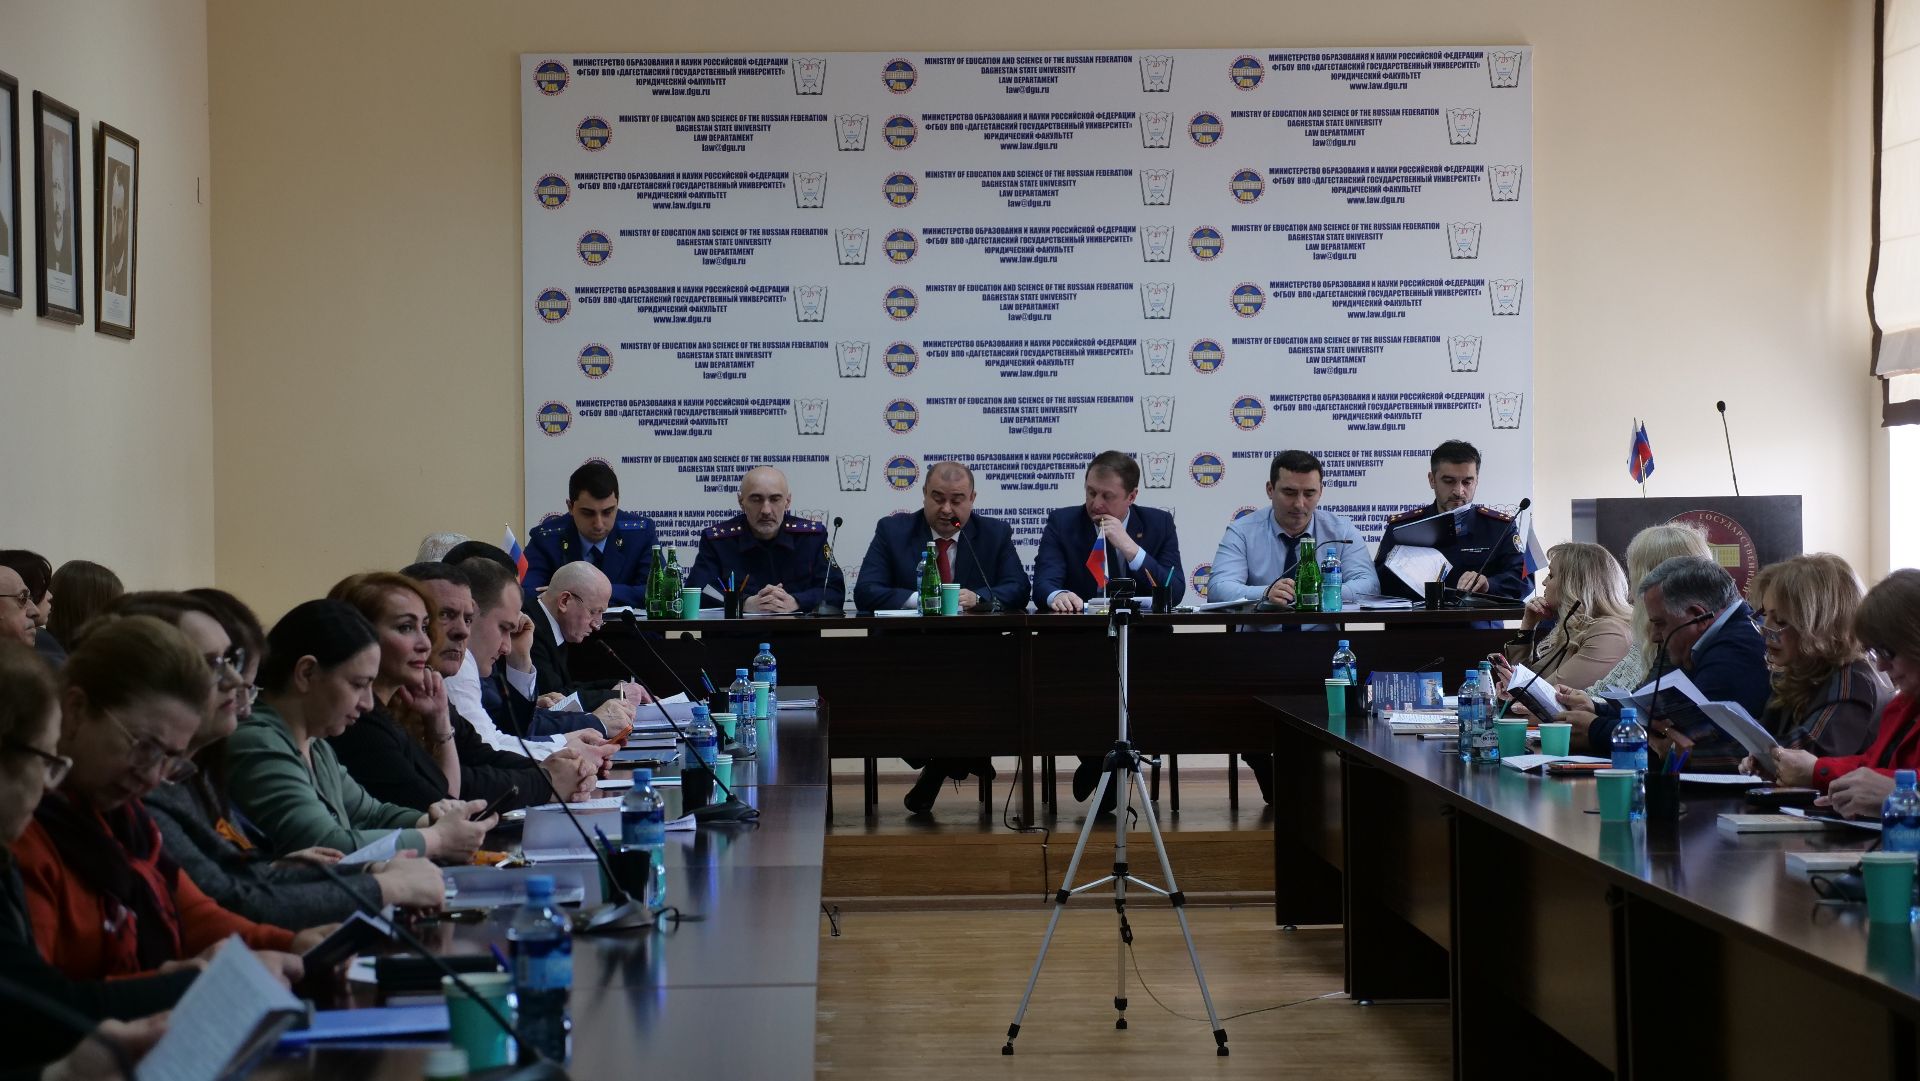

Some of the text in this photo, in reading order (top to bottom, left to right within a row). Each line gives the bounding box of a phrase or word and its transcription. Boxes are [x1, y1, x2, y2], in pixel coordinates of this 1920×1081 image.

[675, 58, 680, 66] И
[681, 58, 702, 66] НАУКИ
[748, 57, 788, 66] ФЕДЕРАЦИИ
[924, 57, 955, 65] MINISTRY
[956, 57, 964, 65] OF
[965, 57, 1001, 65] EDUCATION
[1002, 56, 1015, 64] AND
[1016, 56, 1043, 64] SCIENCE
[1044, 56, 1052, 64] OF
[1053, 56, 1065, 64] THE
[1066, 56, 1094, 64] RUSSIAN
[577, 69, 599, 77] ФГБОУ
[602, 68, 616, 77] ВПО
[981, 66, 1018, 74] DAGHESTAN
[1019, 66, 1037, 74] STATE
[687, 77, 726, 85] ФАКУЛЬТЕТ
[998, 76, 1013, 84] LAW
[652, 88, 710, 96] www.law.dgu.ru
[1231, 110, 1261, 118] MINISTRY
[1263, 110, 1270, 118] OF
[1272, 109, 1307, 117] EDUCATION
[1308, 109, 1321, 117] AND
[1322, 109, 1349, 117] SCIENCE
[1350, 109, 1358, 117] OF
[1360, 109, 1371, 117] THE
[1372, 109, 1400, 117] RUSSIAN
[1287, 119, 1324, 127] DAGHESTAN
[1325, 119, 1343, 127] STATE
[922, 225, 1137, 235] МИНИСТЕРСТВО ОБРАЗОВАНИЯ И НАУКИ РОССИЙСКОЙ ФЕДЕРАЦИИ
[1231, 222, 1439, 232] MINISTRY OF EDUCATION AND SCIENCE OF THE RUSSIAN FEDERATION
[620, 227, 828, 237] MINISTRY OF EDUCATION AND SCIENCE OF THE RUSSIAN FEDERATION
[925, 237, 948, 245] ФГБОУ
[950, 236, 964, 245] ВПО
[1020, 235, 1085, 244] ГОСУДАРСТВЕННЫЙ
[1288, 233, 1383, 241] DAGHESTAN STATE UNIVERSITY
[676, 238, 772, 246] DAGHESTAN STATE UNIVERSITY
[984, 245, 1074, 254] ЮРИДИЧЕСКИЙ ФАКУЛЬТЕТ
[1305, 243, 1366, 251] LAW DEPARTAMENT
[694, 248, 754, 256] LAW DEPARTAMENT
[1000, 256, 1057, 264] www.law.dgu.ru
[926, 395, 1134, 405] MINISTRY OF EDUCATION AND SCIENCE OF THE RUSSIAN FEDERATION
[1270, 392, 1484, 402] МИНИСТЕРСТВО ОБРАЗОВАНИЯ И НАУКИ РОССИЙСКОЙ ФЕДЕРАЦИИ
[576, 398, 790, 408] МИНИСТЕРСТВО ОБРАЗОВАНИЯ И НАУКИ РОССИЙСКОЙ ФЕДЕРАЦИИ
[1273, 403, 1296, 412] ФГБОУ
[1298, 403, 1312, 411] ВПО
[1367, 402, 1433, 411] ГОСУДАРСТВЕННЫЙ
[579, 409, 602, 417] ФГБОУ
[604, 409, 618, 417] ВПО
[673, 408, 739, 416] ГОСУДАРСТВЕННЫЙ
[982, 406, 1078, 414] DAGHESTAN STATE UNIVERSITY
[1000, 416, 1060, 424] LAW DEPARTAMENT
[1332, 412, 1422, 421] ЮРИДИЧЕСКИЙ ФАКУЛЬТЕТ
[638, 418, 728, 426] ЮРИДИЧЕСКИЙ ФАКУЛЬТЕТ
[1348, 423, 1405, 431] www.law.dgu.ru
[654, 428, 712, 437] www.law.dgu.ru
[621, 454, 829, 464] MINISTRY OF EDUCATION AND SCIENCE OF THE RUSSIAN FEDERATION
[678, 465, 715, 473] DAGHESTAN
[985, 472, 1036, 480] ЮРИДИЧЕСКИЙ
[1000, 482, 1058, 490] www.law.dgu.ru
